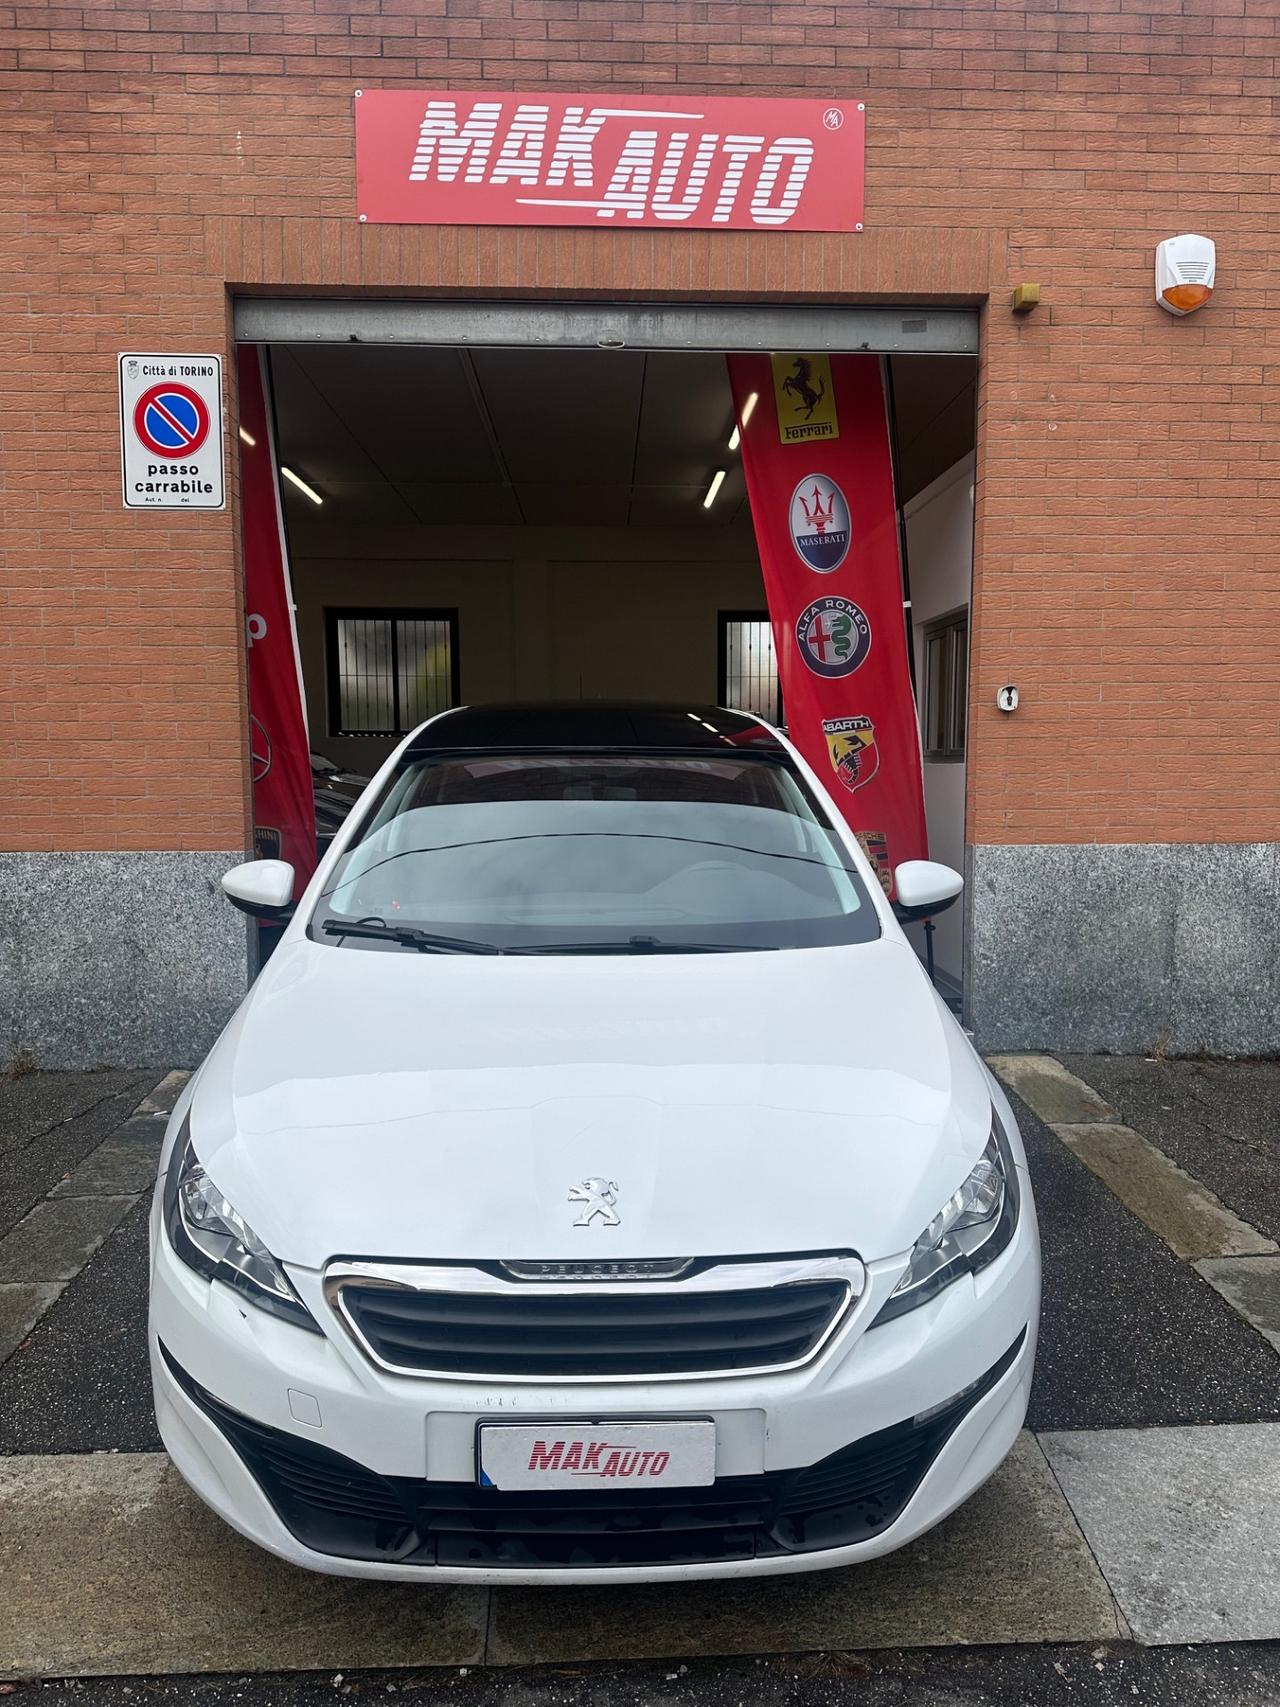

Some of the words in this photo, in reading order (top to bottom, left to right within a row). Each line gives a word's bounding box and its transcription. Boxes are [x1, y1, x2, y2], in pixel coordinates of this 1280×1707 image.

[143, 365, 166, 376] Città
[168, 366, 177, 376] di
[180, 366, 214, 376] TORINO
[784, 422, 833, 439] Ferrari
[148, 464, 199, 477] passo
[134, 480, 213, 493] carrabile
[800, 534, 845, 547] MASERATI
[798, 606, 820, 642] ALFA
[825, 600, 868, 634] ROMEO
[540, 1264, 654, 1274] PEUGEOT
[528, 1441, 608, 1470] MAK
[600, 1452, 670, 1477] AUTO
